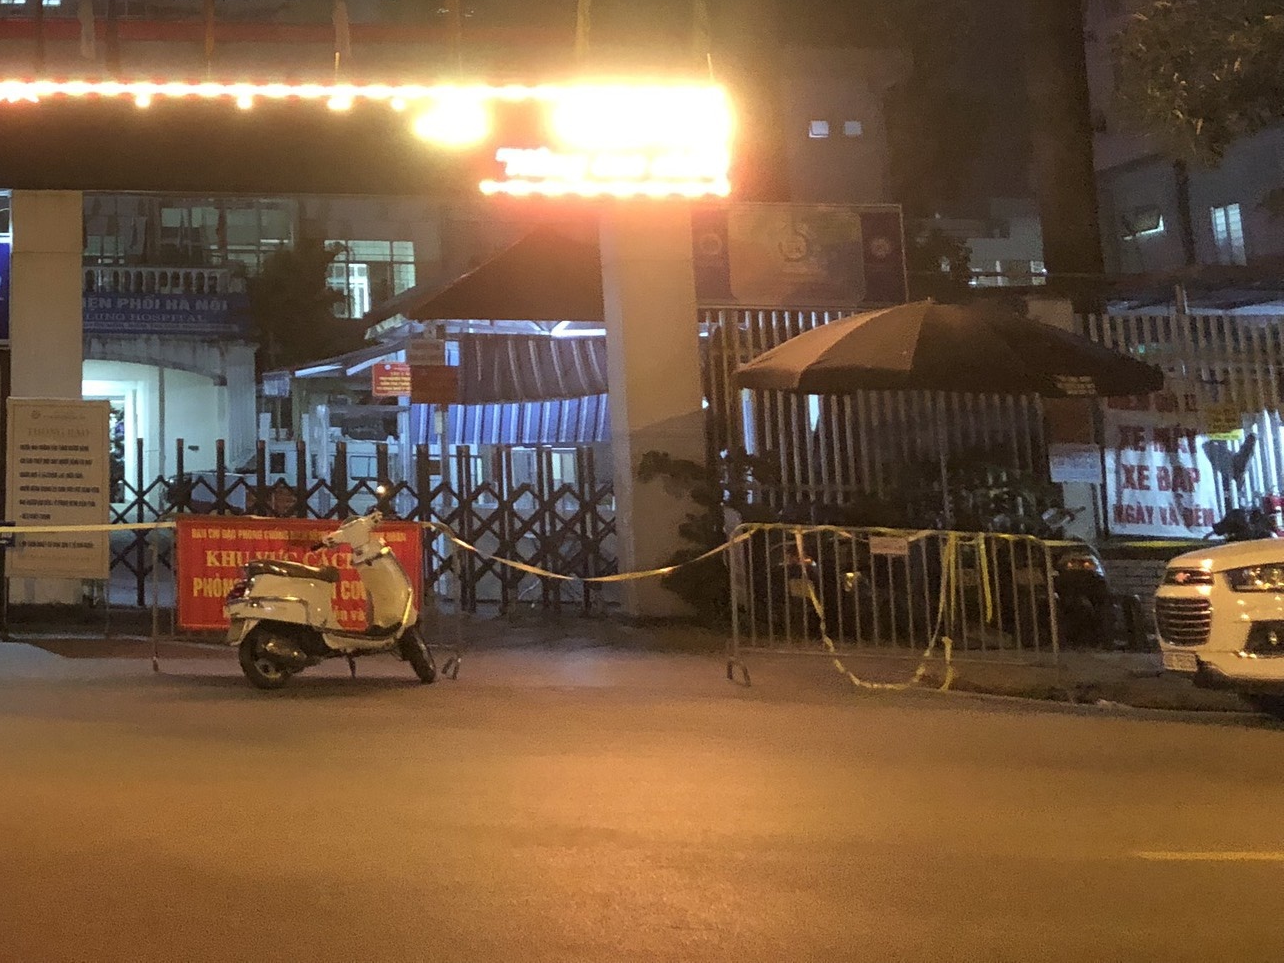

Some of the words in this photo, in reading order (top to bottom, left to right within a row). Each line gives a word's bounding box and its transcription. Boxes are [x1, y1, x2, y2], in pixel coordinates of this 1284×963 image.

[116, 294, 161, 310] PHỔI
[166, 294, 190, 311] HÀ
[195, 296, 228, 314] NỘI
[130, 313, 205, 322] HOSPITAL
[1118, 424, 1145, 452] XE
[1153, 422, 1197, 453] MÁY
[1122, 464, 1150, 491] XE
[1113, 500, 1154, 524] NGÀY
[1159, 502, 1179, 526] VÀ
[205, 550, 250, 567] KHU
